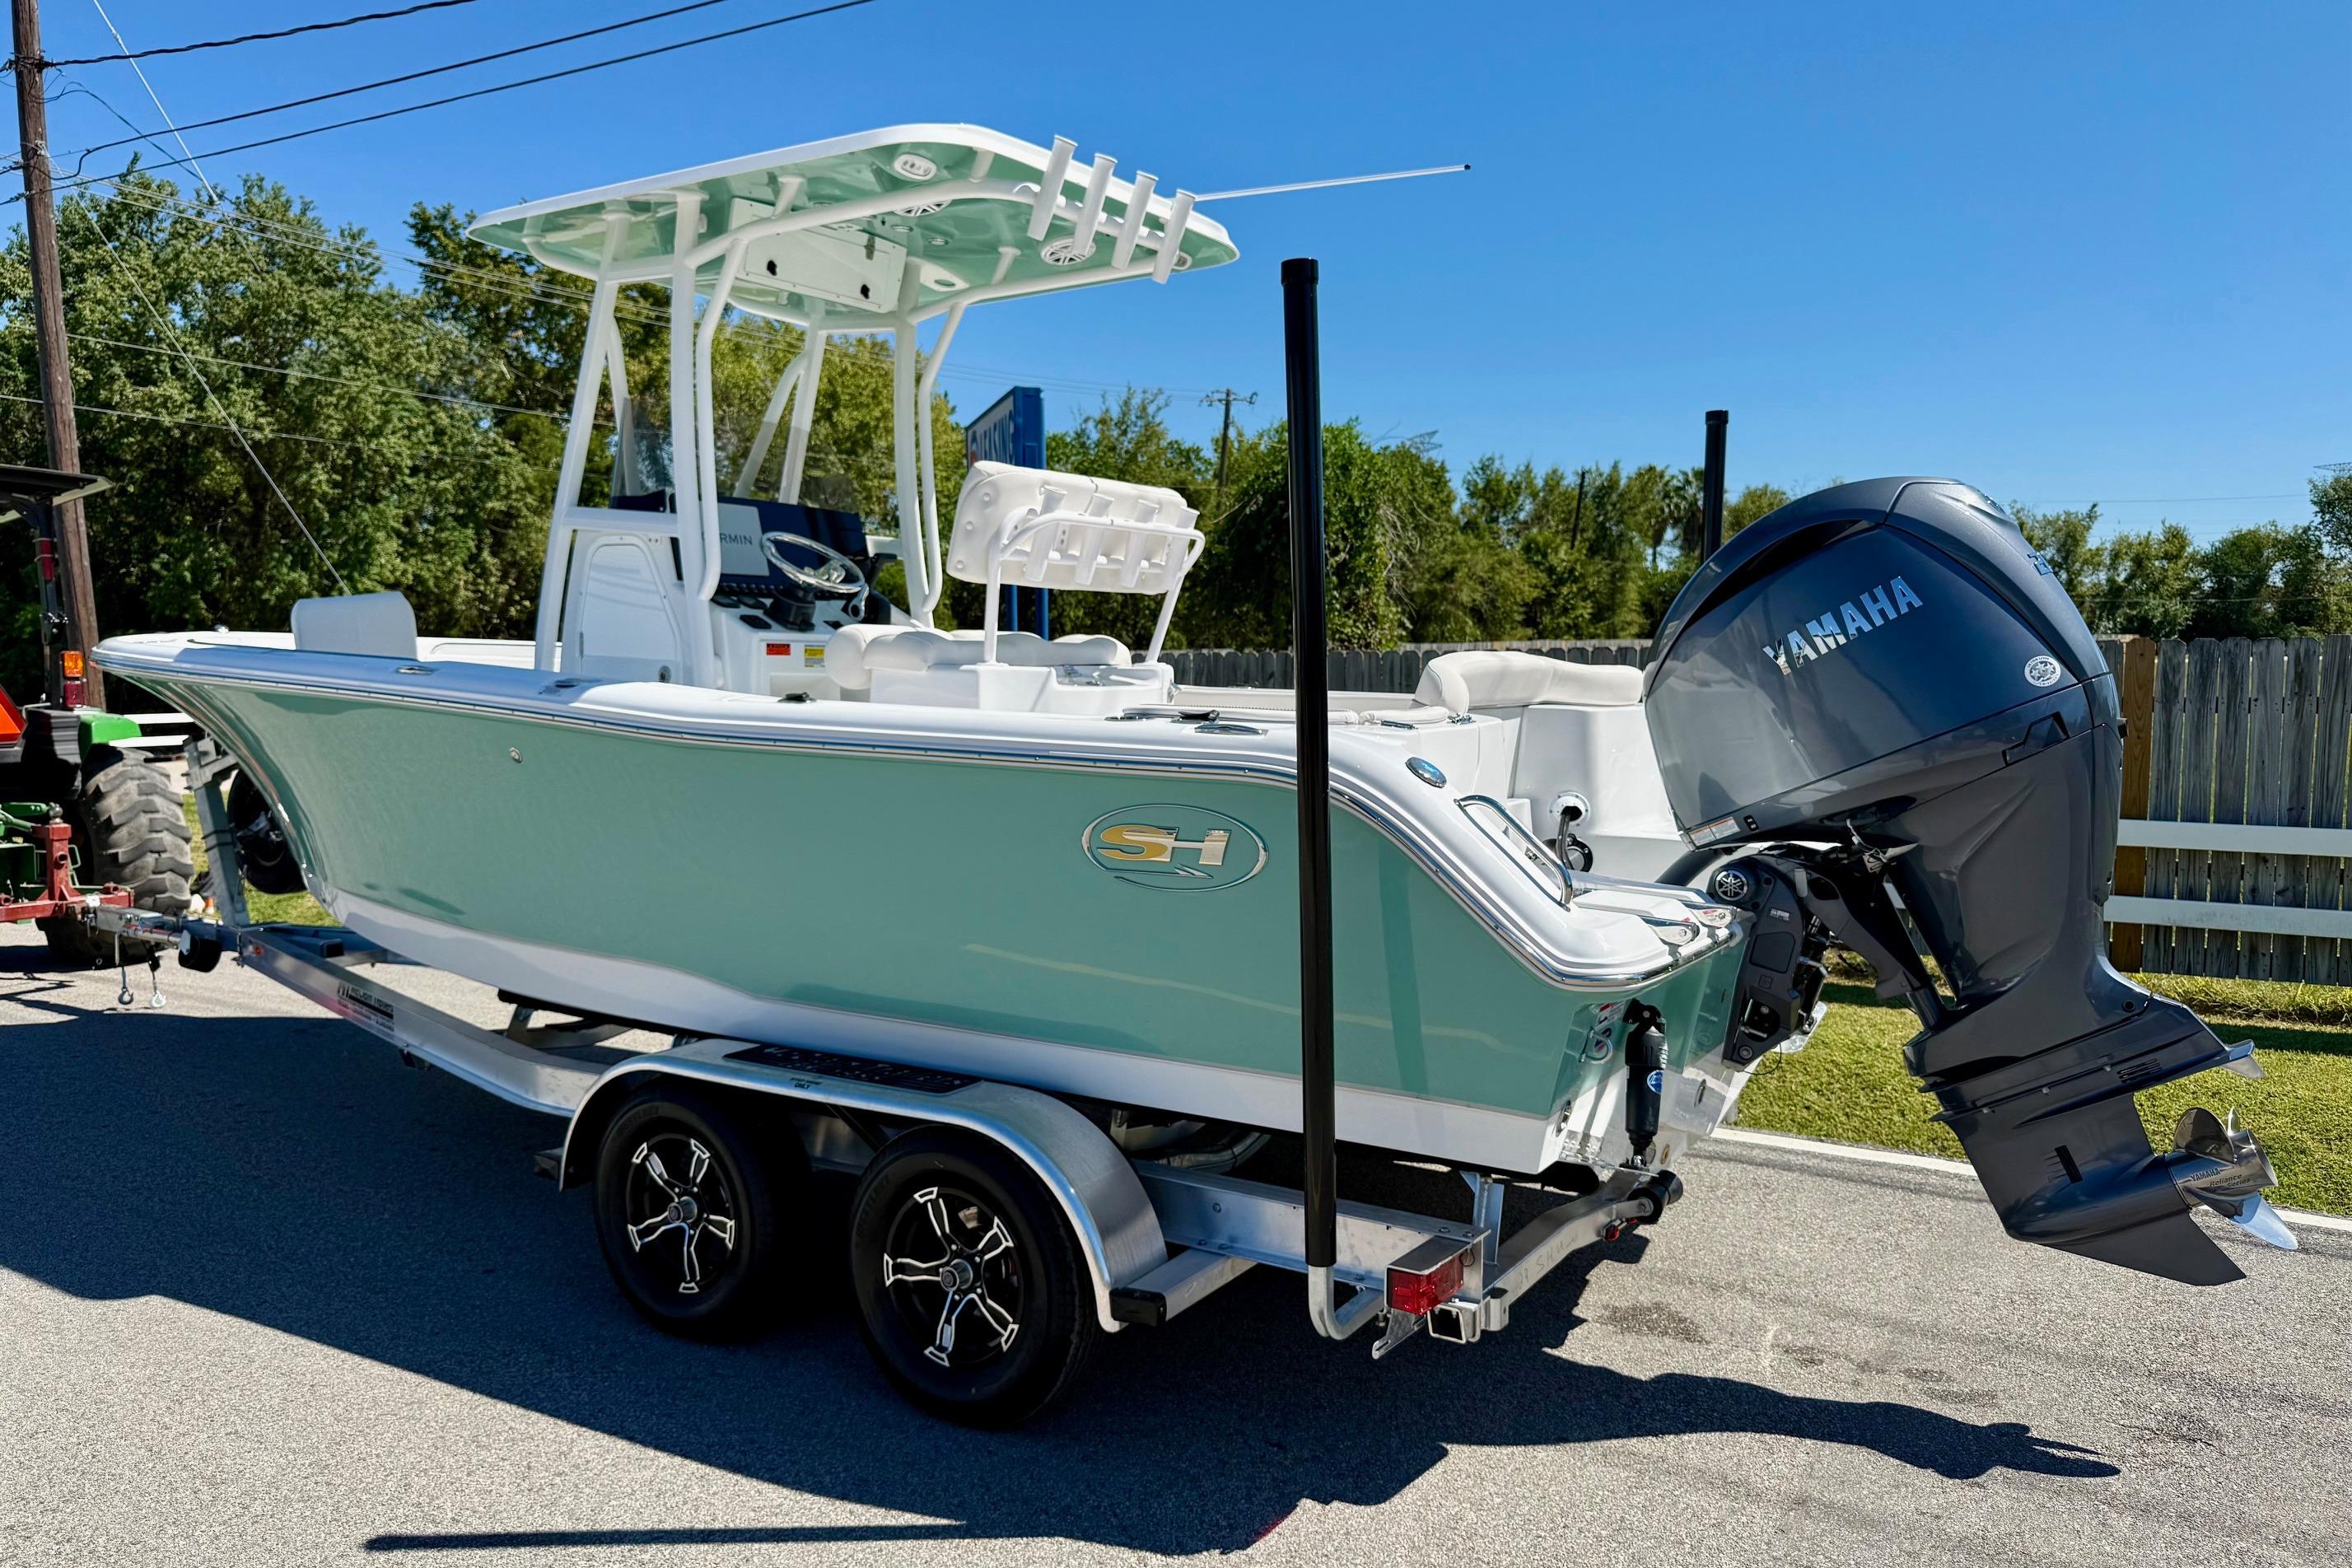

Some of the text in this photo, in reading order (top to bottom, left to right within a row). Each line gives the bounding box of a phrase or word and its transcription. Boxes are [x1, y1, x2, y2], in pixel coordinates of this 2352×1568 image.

[720, 532, 753, 546] RMIN
[1762, 575, 1924, 676] YAMAHA
[1096, 824, 1233, 866] SH
[2191, 1167, 2222, 1182] YAMAHA
[2210, 1174, 2242, 1187] Reliance
[2226, 1176, 2252, 1187] Series
